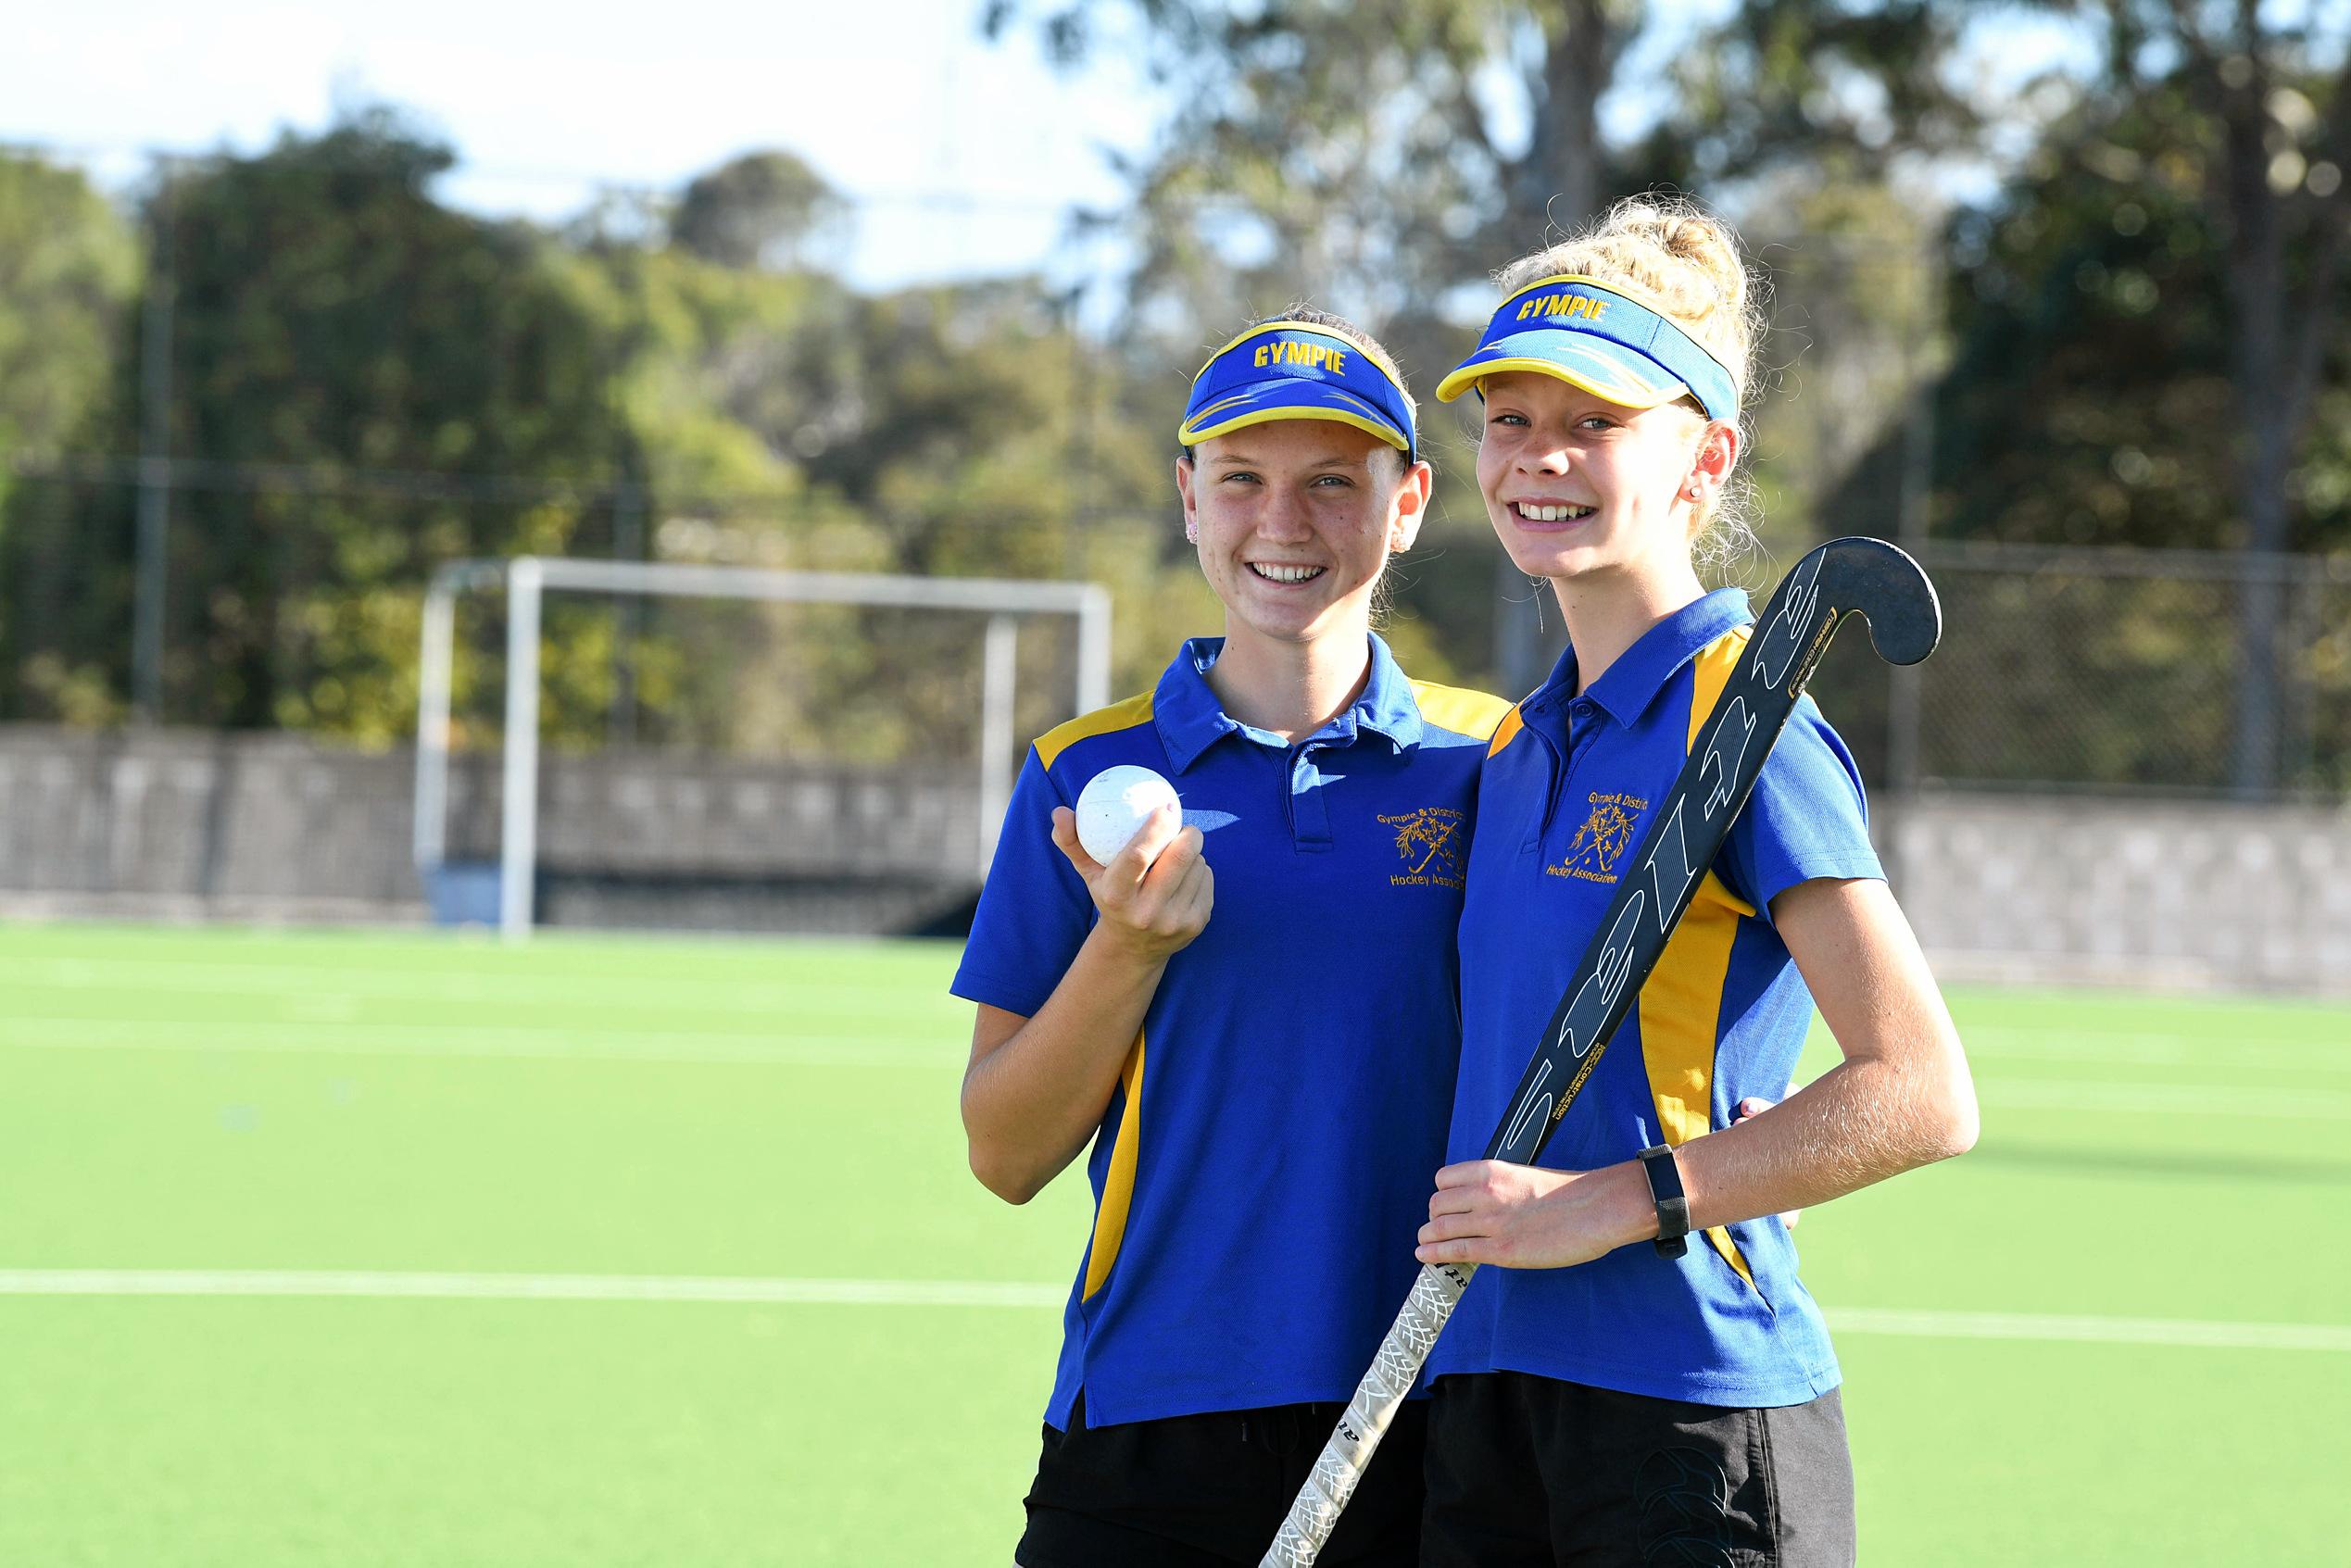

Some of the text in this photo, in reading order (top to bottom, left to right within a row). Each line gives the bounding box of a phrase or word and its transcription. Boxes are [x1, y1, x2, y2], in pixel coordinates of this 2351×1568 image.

[1516, 295, 1610, 322] GYMPIE
[1254, 341, 1346, 376] GYMPIE
[1614, 793, 1622, 804] &
[1377, 811, 1417, 824] Gympie
[1418, 808, 1427, 817] &
[1389, 873, 1429, 886] Hockey
[1546, 863, 1618, 884] Hockey Association
[1338, 1421, 1359, 1442] at
